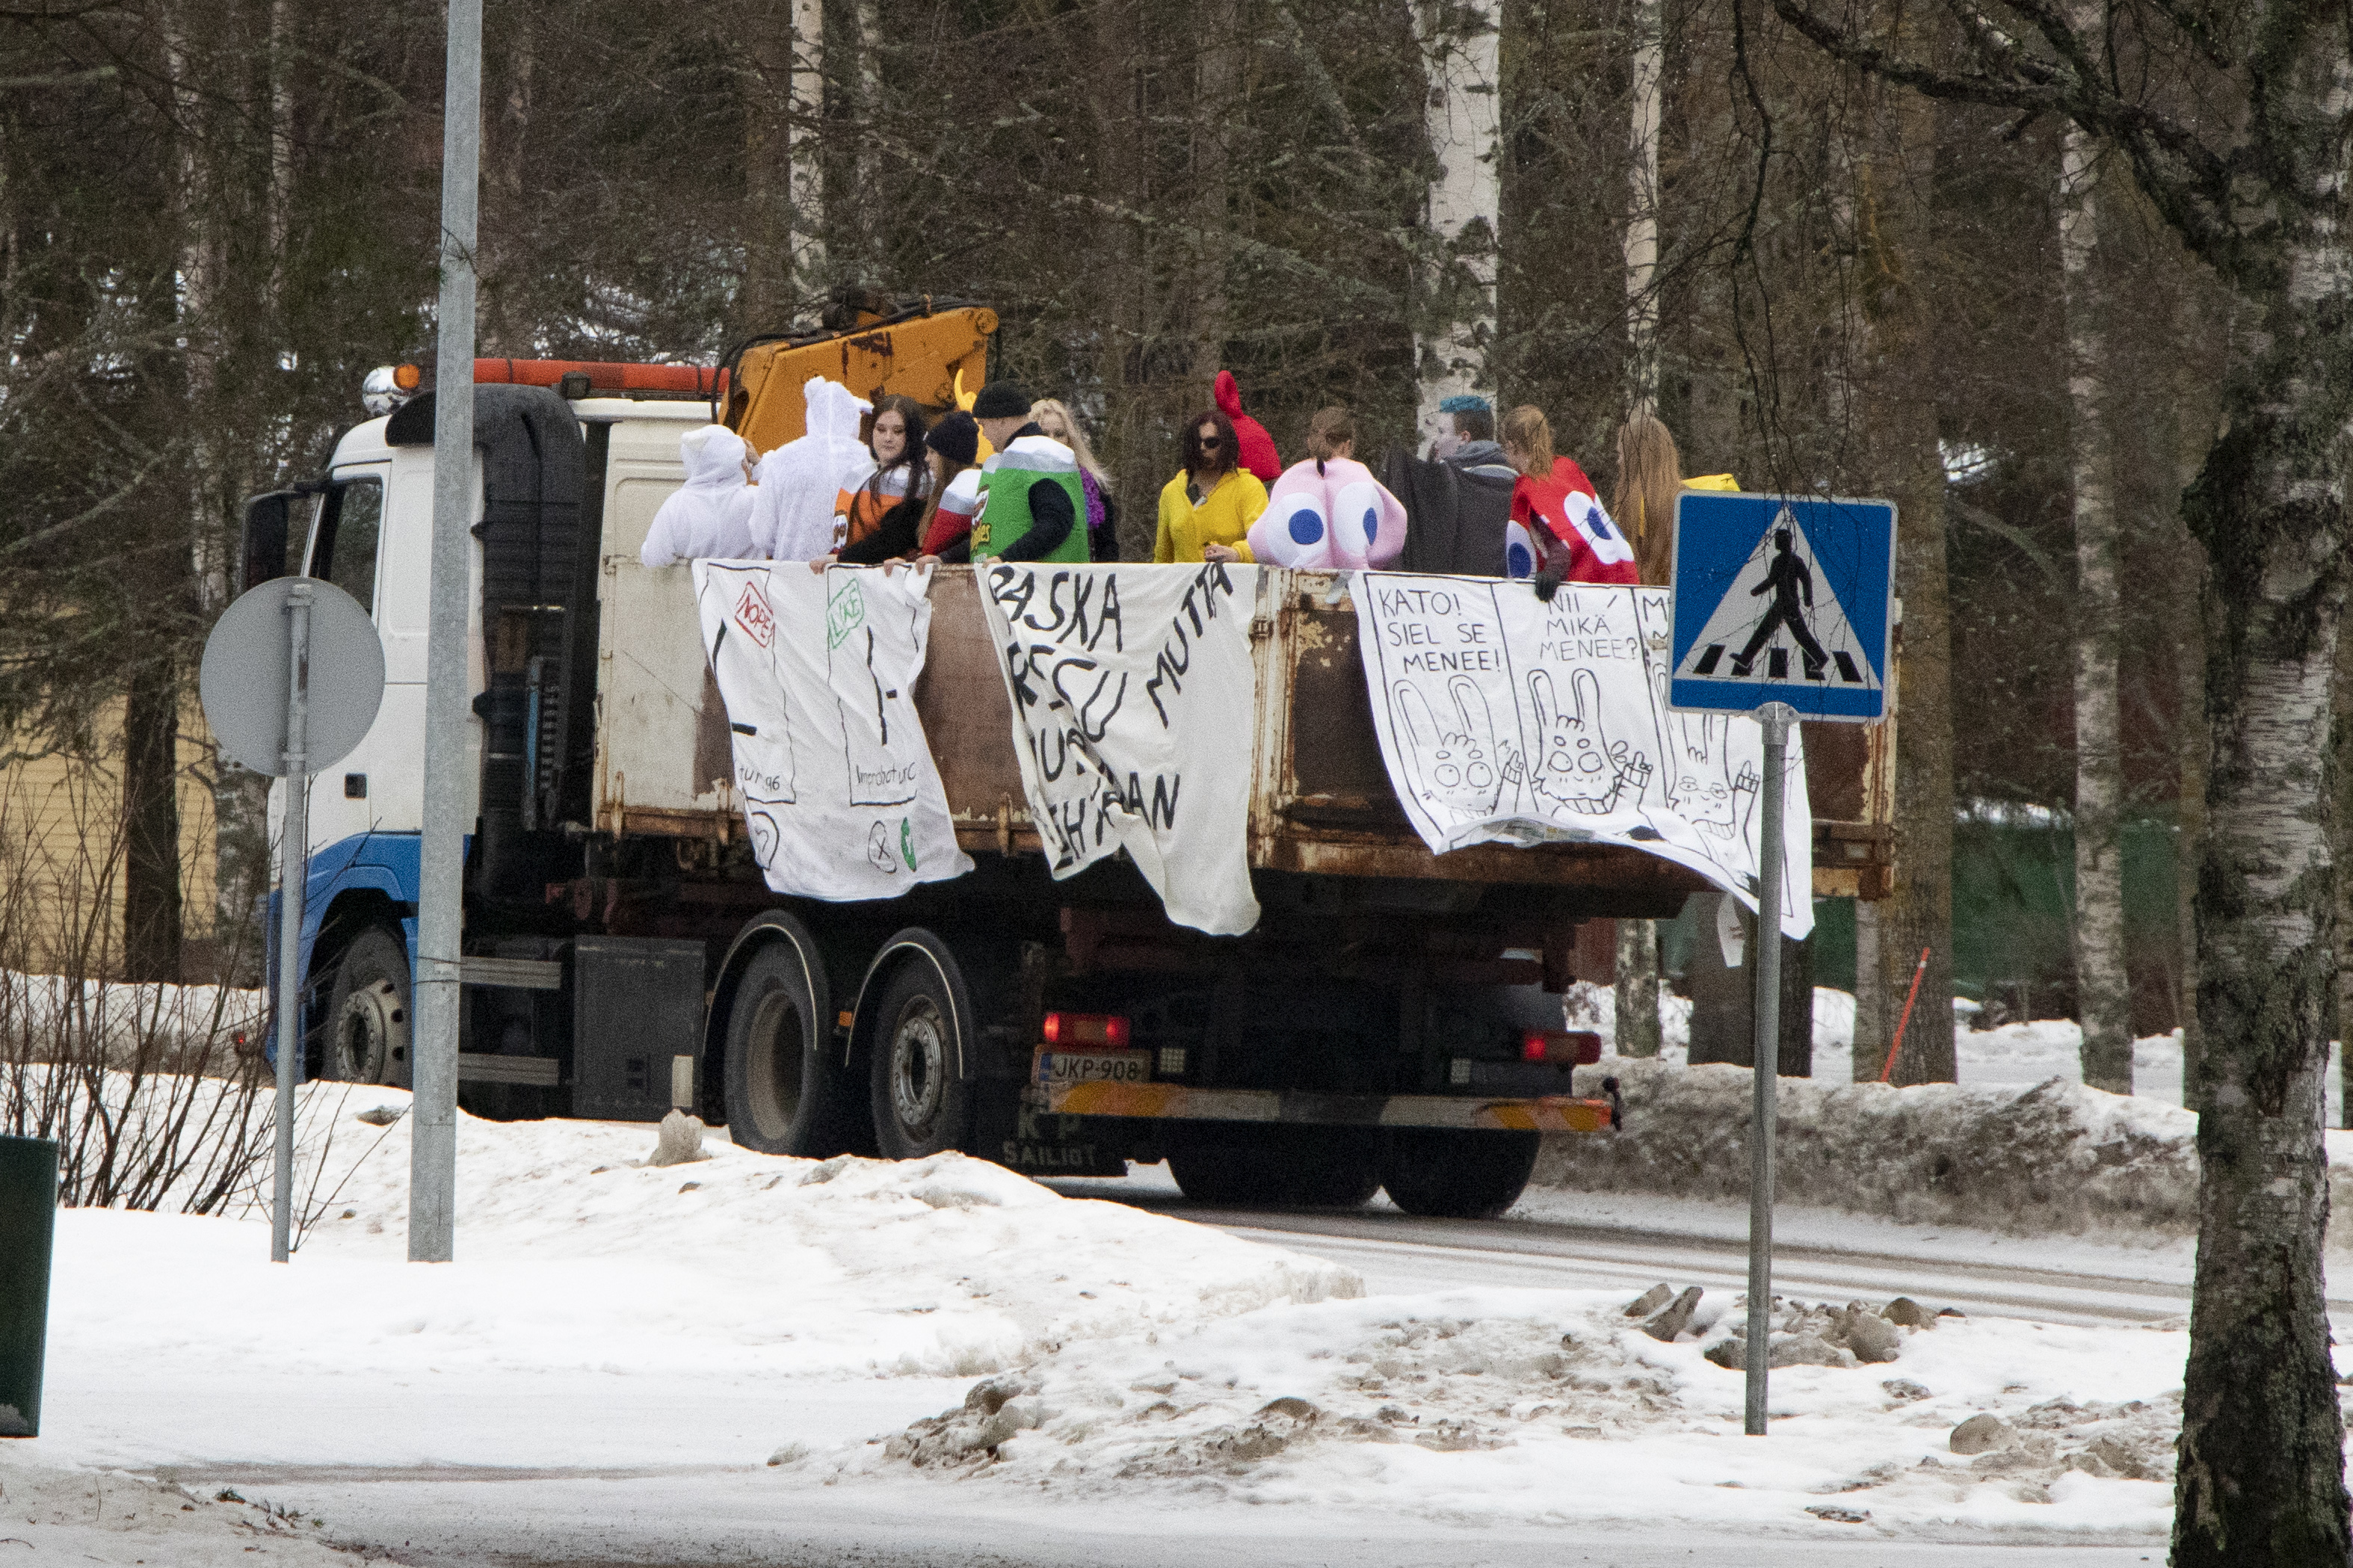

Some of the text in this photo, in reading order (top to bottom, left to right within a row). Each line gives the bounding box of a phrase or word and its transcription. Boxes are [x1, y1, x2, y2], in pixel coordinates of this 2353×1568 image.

[742, 593, 772, 640] NOPE
[830, 587, 860, 638] LIKE
[988, 565, 1122, 654] PASKA
[1378, 588, 1462, 619] KATO!
[1387, 621, 1487, 647] SIEL SE
[1546, 614, 1612, 637] MIKÄ
[1146, 562, 1233, 729] MUTTA
[1539, 636, 1638, 661] MENEE?
[1403, 648, 1502, 674] MENEE!
[1055, 1056, 1140, 1081] JKP-908
